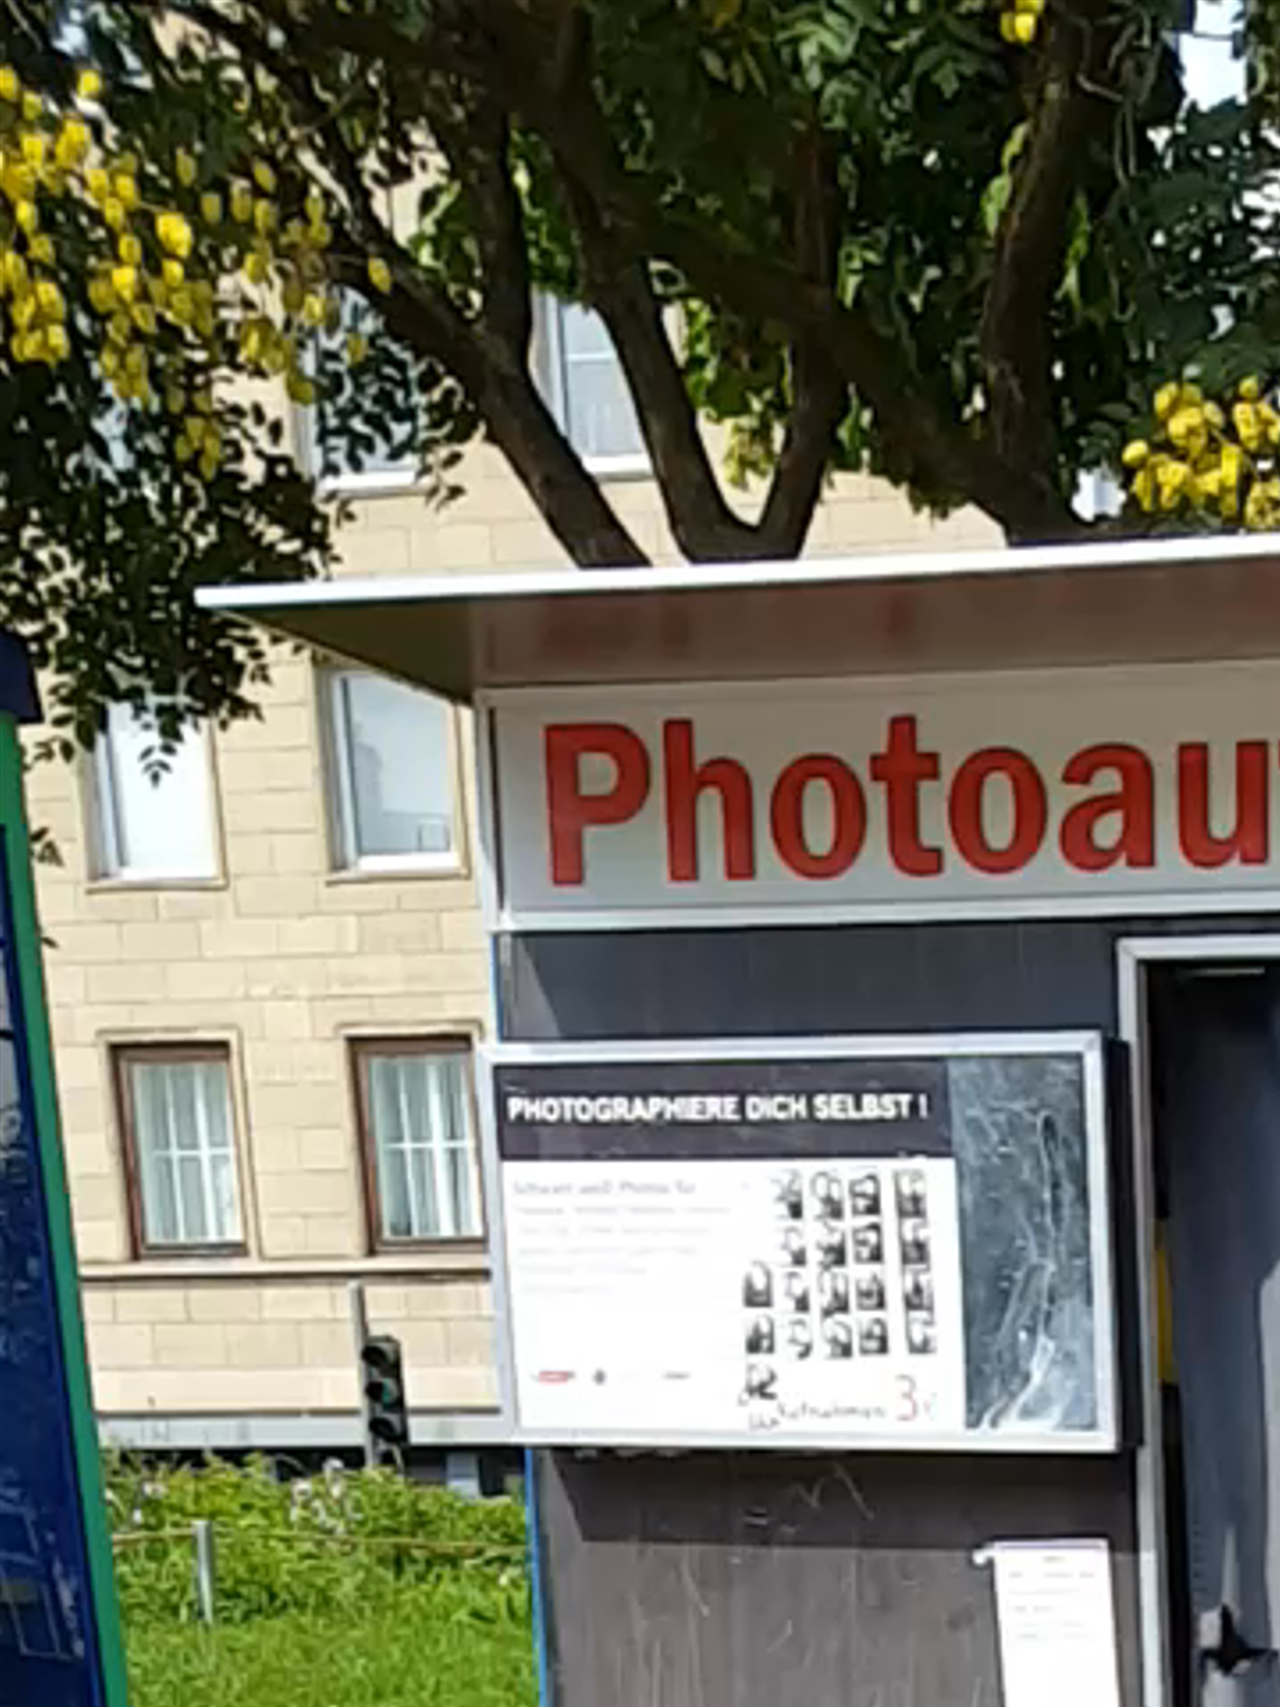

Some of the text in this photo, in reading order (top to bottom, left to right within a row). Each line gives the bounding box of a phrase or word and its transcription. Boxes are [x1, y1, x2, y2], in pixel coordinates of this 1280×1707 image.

[508, 1095, 741, 1123] PHOTOGRAPHIERE
[745, 1093, 806, 1122] DICH
[815, 1092, 912, 1120] SELBST
